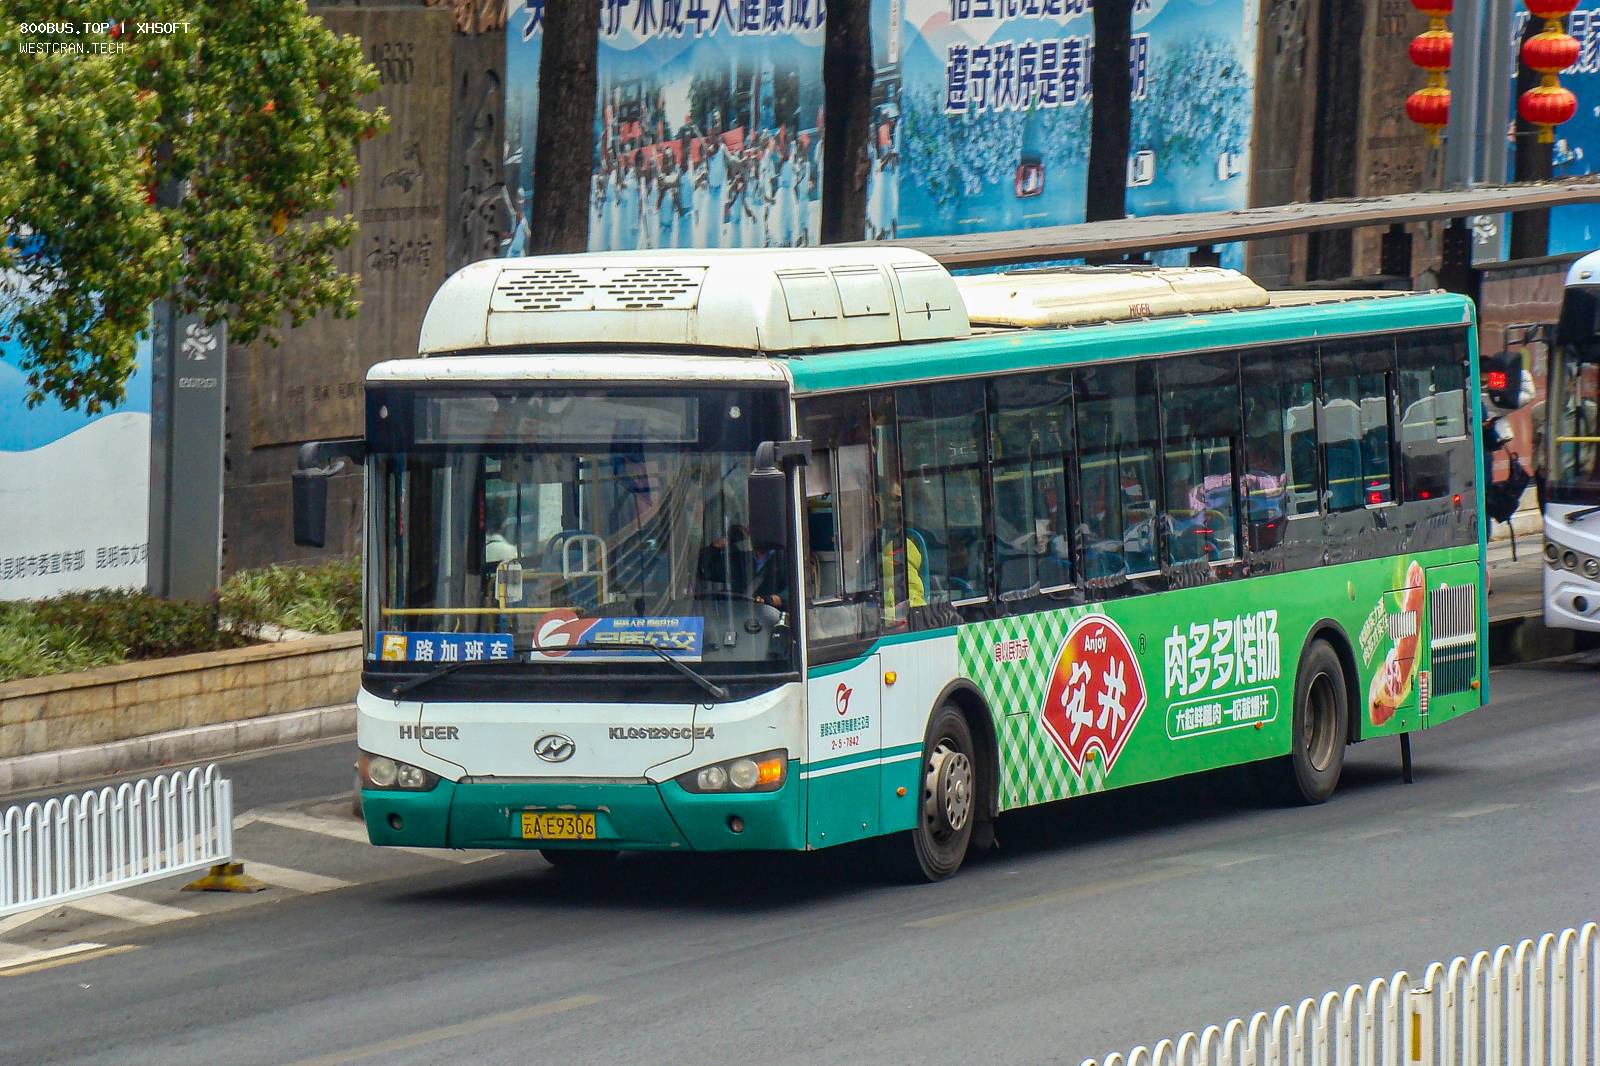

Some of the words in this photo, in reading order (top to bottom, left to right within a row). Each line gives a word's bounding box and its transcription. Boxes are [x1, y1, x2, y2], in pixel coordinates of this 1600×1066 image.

[1128, 303, 1151, 317] HIGER
[1084, 628, 1107, 653] Anjoy
[1164, 609, 1280, 699] 肉多多烤肠
[1061, 655, 1127, 746] 安井
[398, 725, 460, 740] HIGER
[608, 726, 716, 741] KLQ6129GCE4
